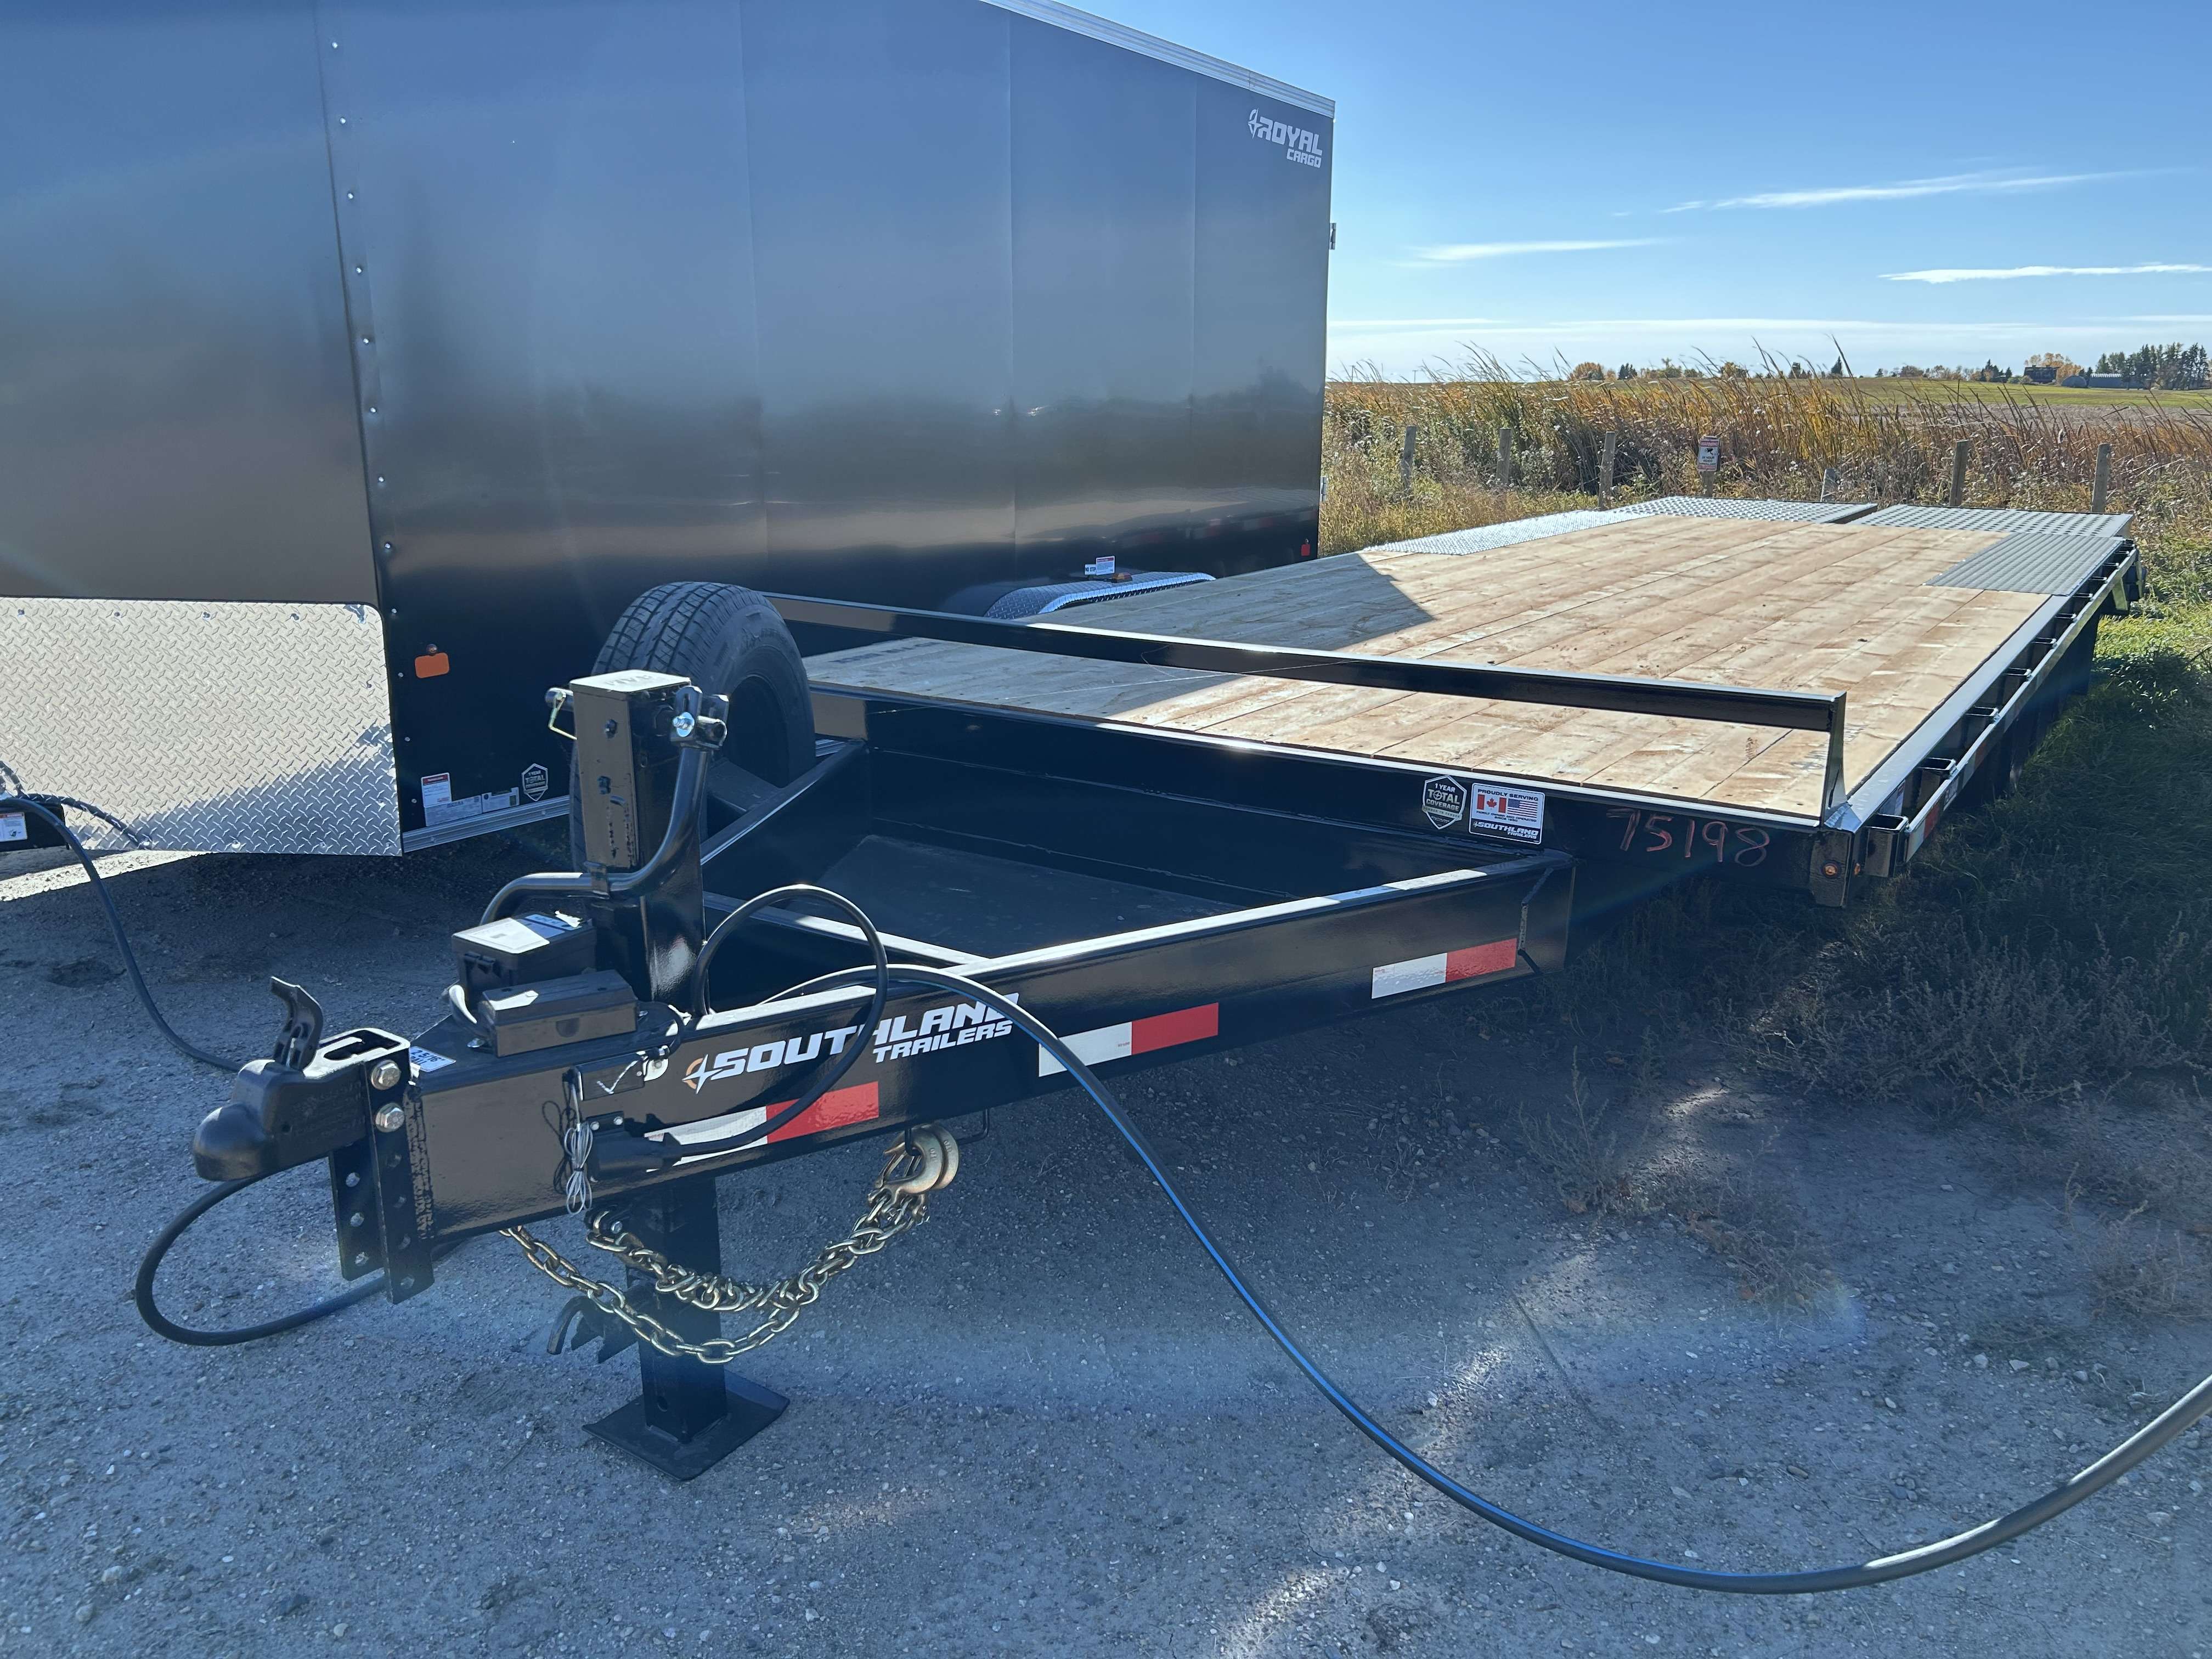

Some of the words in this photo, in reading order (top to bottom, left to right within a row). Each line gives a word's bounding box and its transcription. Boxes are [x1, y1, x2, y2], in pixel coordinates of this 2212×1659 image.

[1257, 116, 1322, 156] ROYAL
[1286, 148, 1322, 168] CARGO
[1439, 784, 1455, 793] YEAR
[1478, 789, 1508, 797] PROUDLY
[1427, 788, 1460, 805] TOTAL
[1426, 799, 1460, 811] COVERAGE
[1477, 822, 1539, 836] SOUTHLAND
[1507, 831, 1537, 839] TRAILERS
[1606, 808, 1770, 867] 75198
[873, 1019, 1013, 1063] TRAILERS
